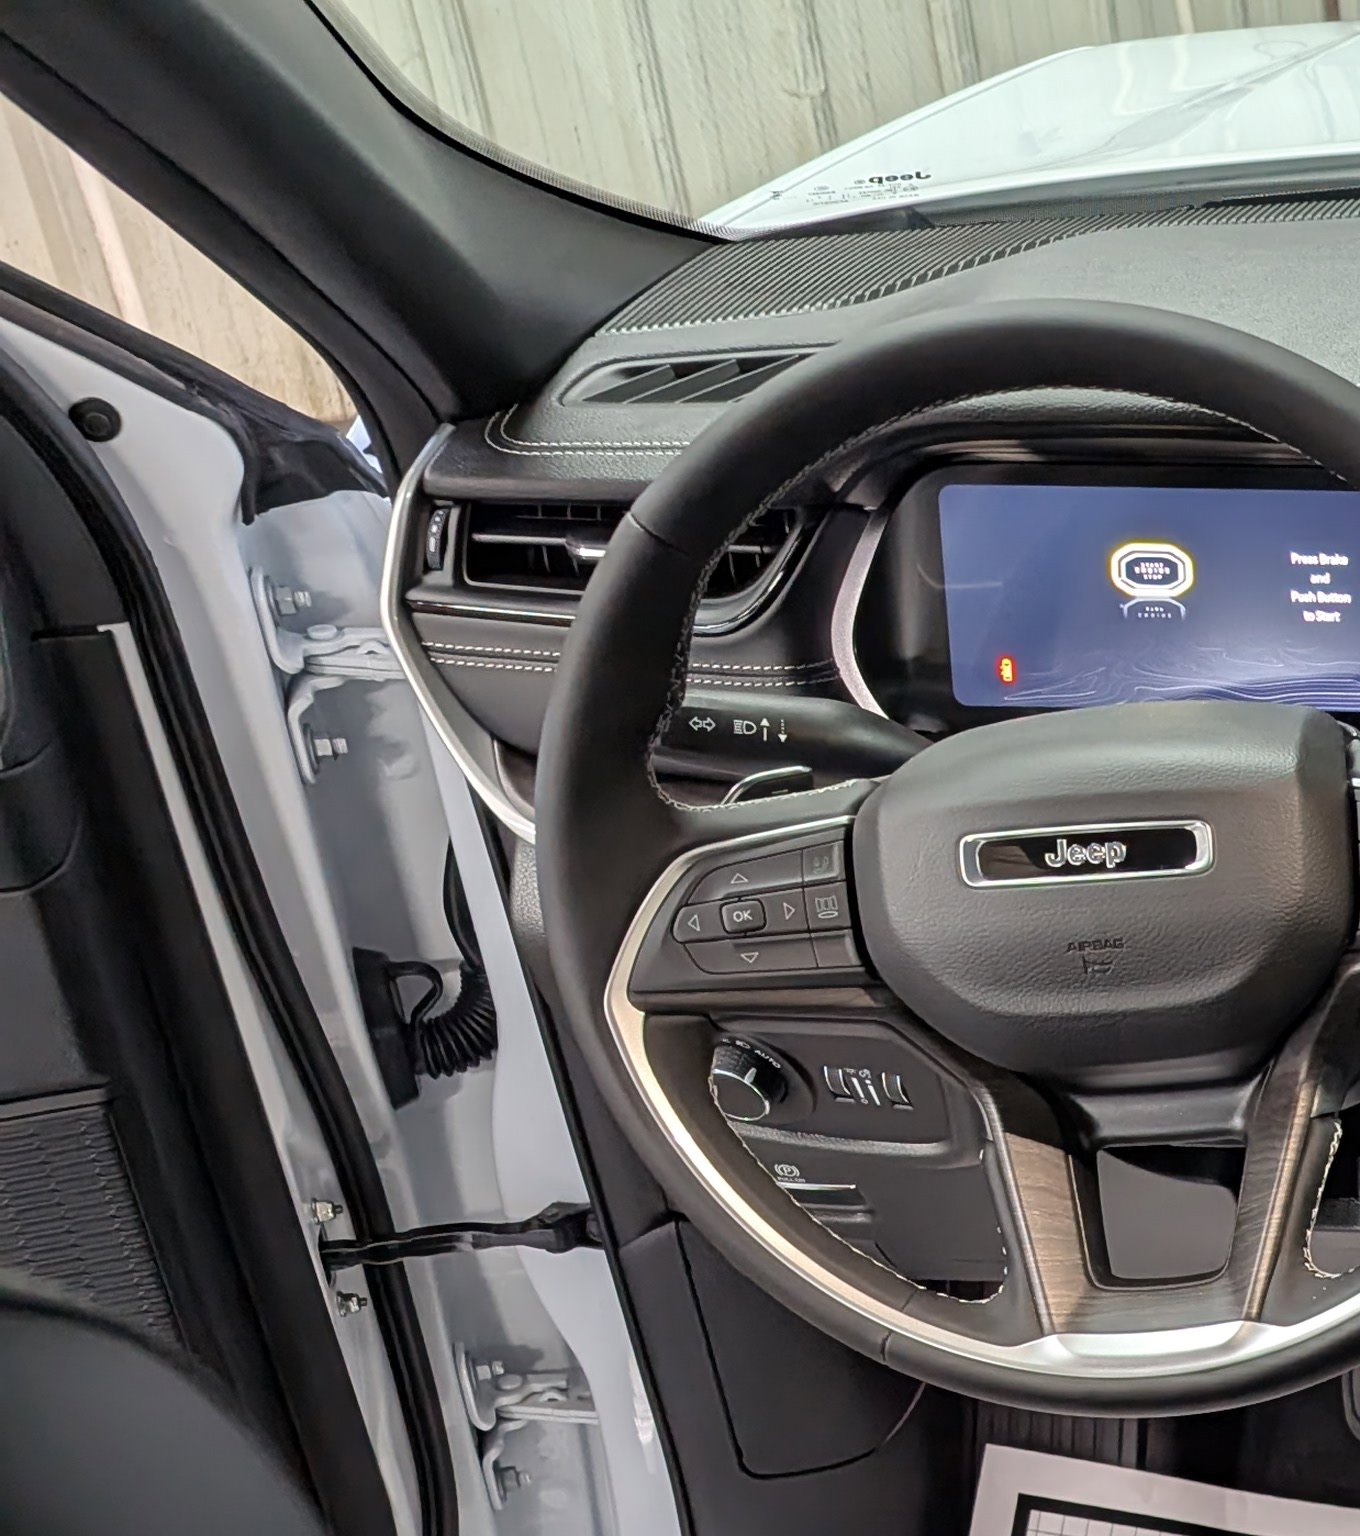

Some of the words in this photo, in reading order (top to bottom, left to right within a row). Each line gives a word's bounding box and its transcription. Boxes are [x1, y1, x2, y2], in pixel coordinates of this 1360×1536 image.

[1290, 551, 1319, 565] Press
[1310, 572, 1331, 584] and
[1290, 590, 1316, 603] Push
[1303, 610, 1316, 622] to
[1315, 609, 1341, 622] Start
[1044, 838, 1127, 868] Jeep
[733, 911, 753, 923] OK
[1066, 937, 1125, 953] AIRBAG
[754, 1049, 782, 1069] AUTO
